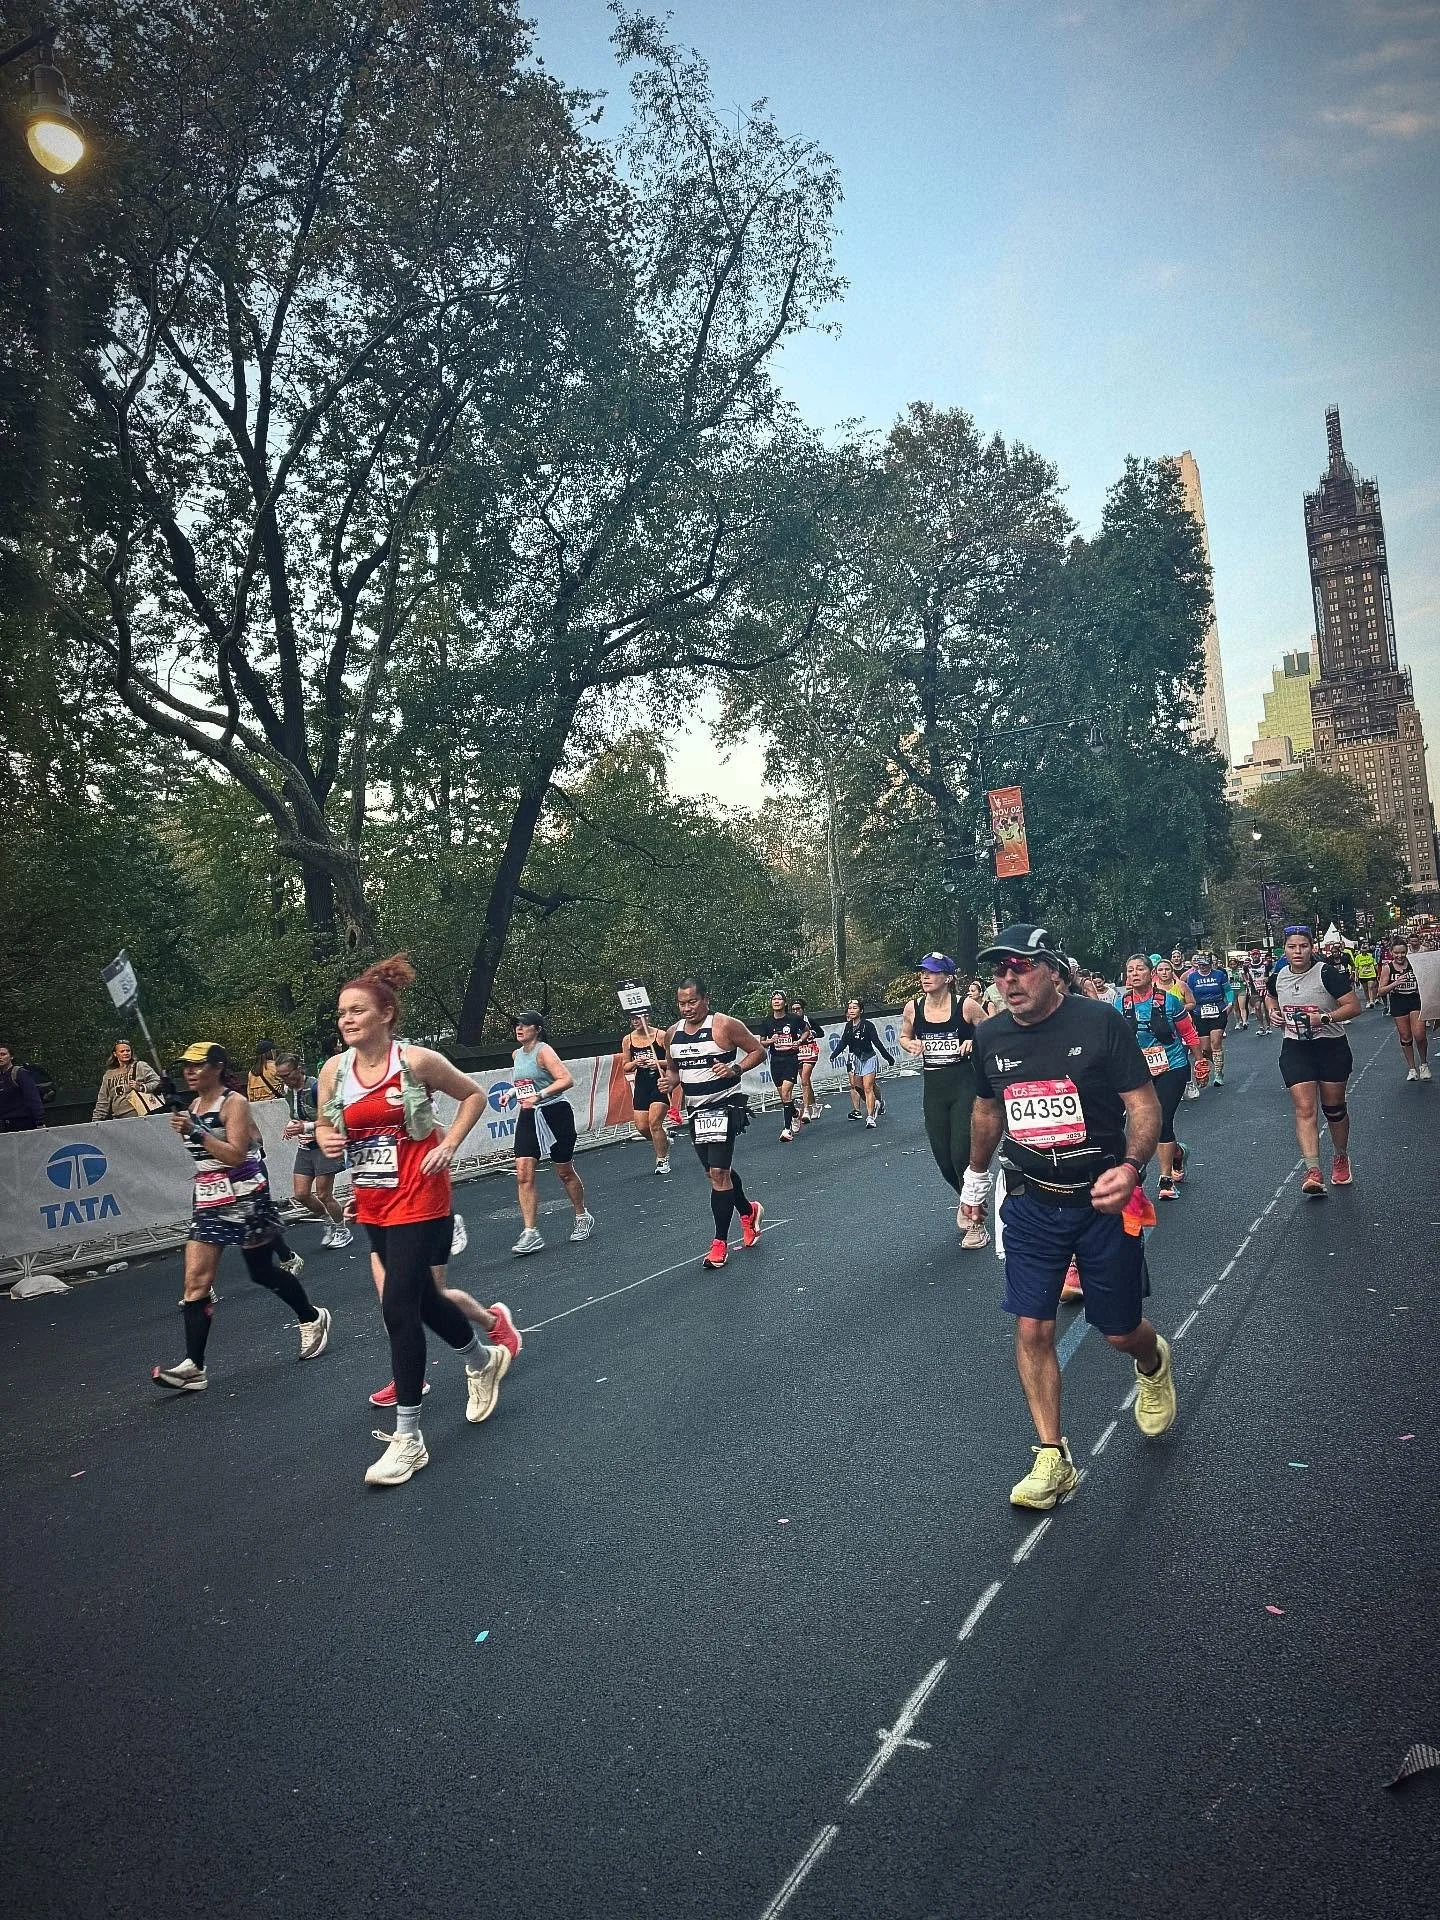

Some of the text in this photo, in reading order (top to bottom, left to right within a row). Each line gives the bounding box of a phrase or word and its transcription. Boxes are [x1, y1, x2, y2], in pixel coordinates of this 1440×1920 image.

[992, 805, 1020, 817] NOV 02
[925, 1040, 957, 1051] 62265
[1010, 1095, 1077, 1121] 64359
[487, 1118, 517, 1139] TAT
[695, 1117, 723, 1130] 11047
[39, 1193, 121, 1230] TATA
